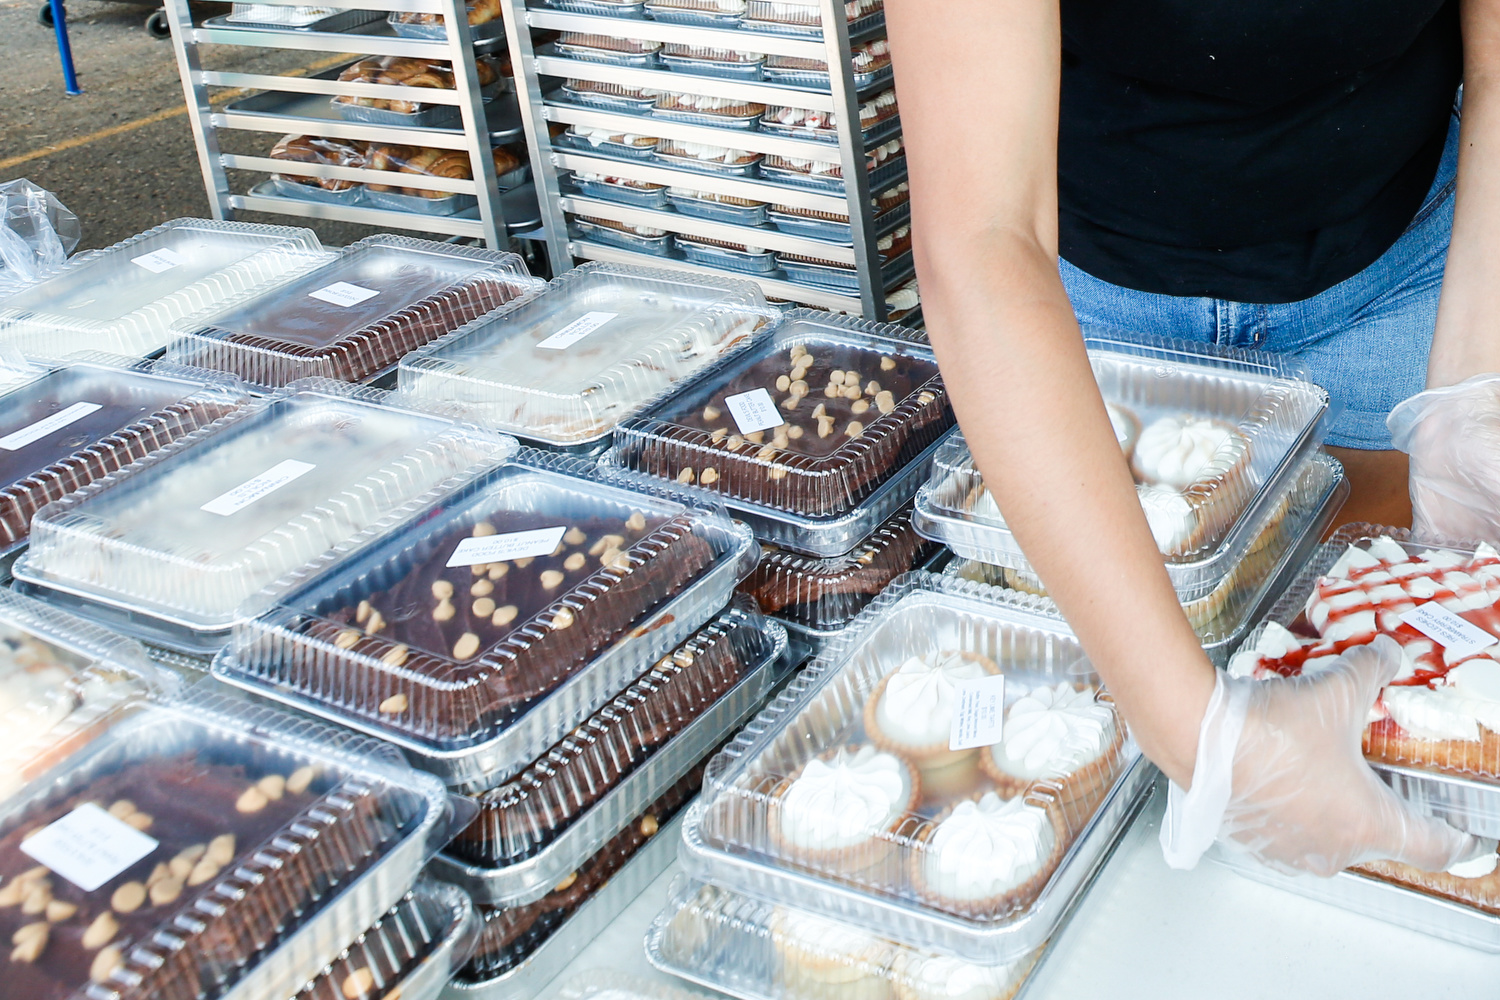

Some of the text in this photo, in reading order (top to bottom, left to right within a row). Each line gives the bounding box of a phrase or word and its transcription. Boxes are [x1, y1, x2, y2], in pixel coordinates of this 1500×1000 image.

[481, 543, 515, 551] BUTTER
[516, 538, 549, 546] PEANUT
[472, 546, 529, 558] DEVIL'S FOOD
[1415, 608, 1476, 645] STRAWBERRY CAKE
[1442, 615, 1463, 628] $10.00
[1415, 616, 1458, 643] TRES LECHES
